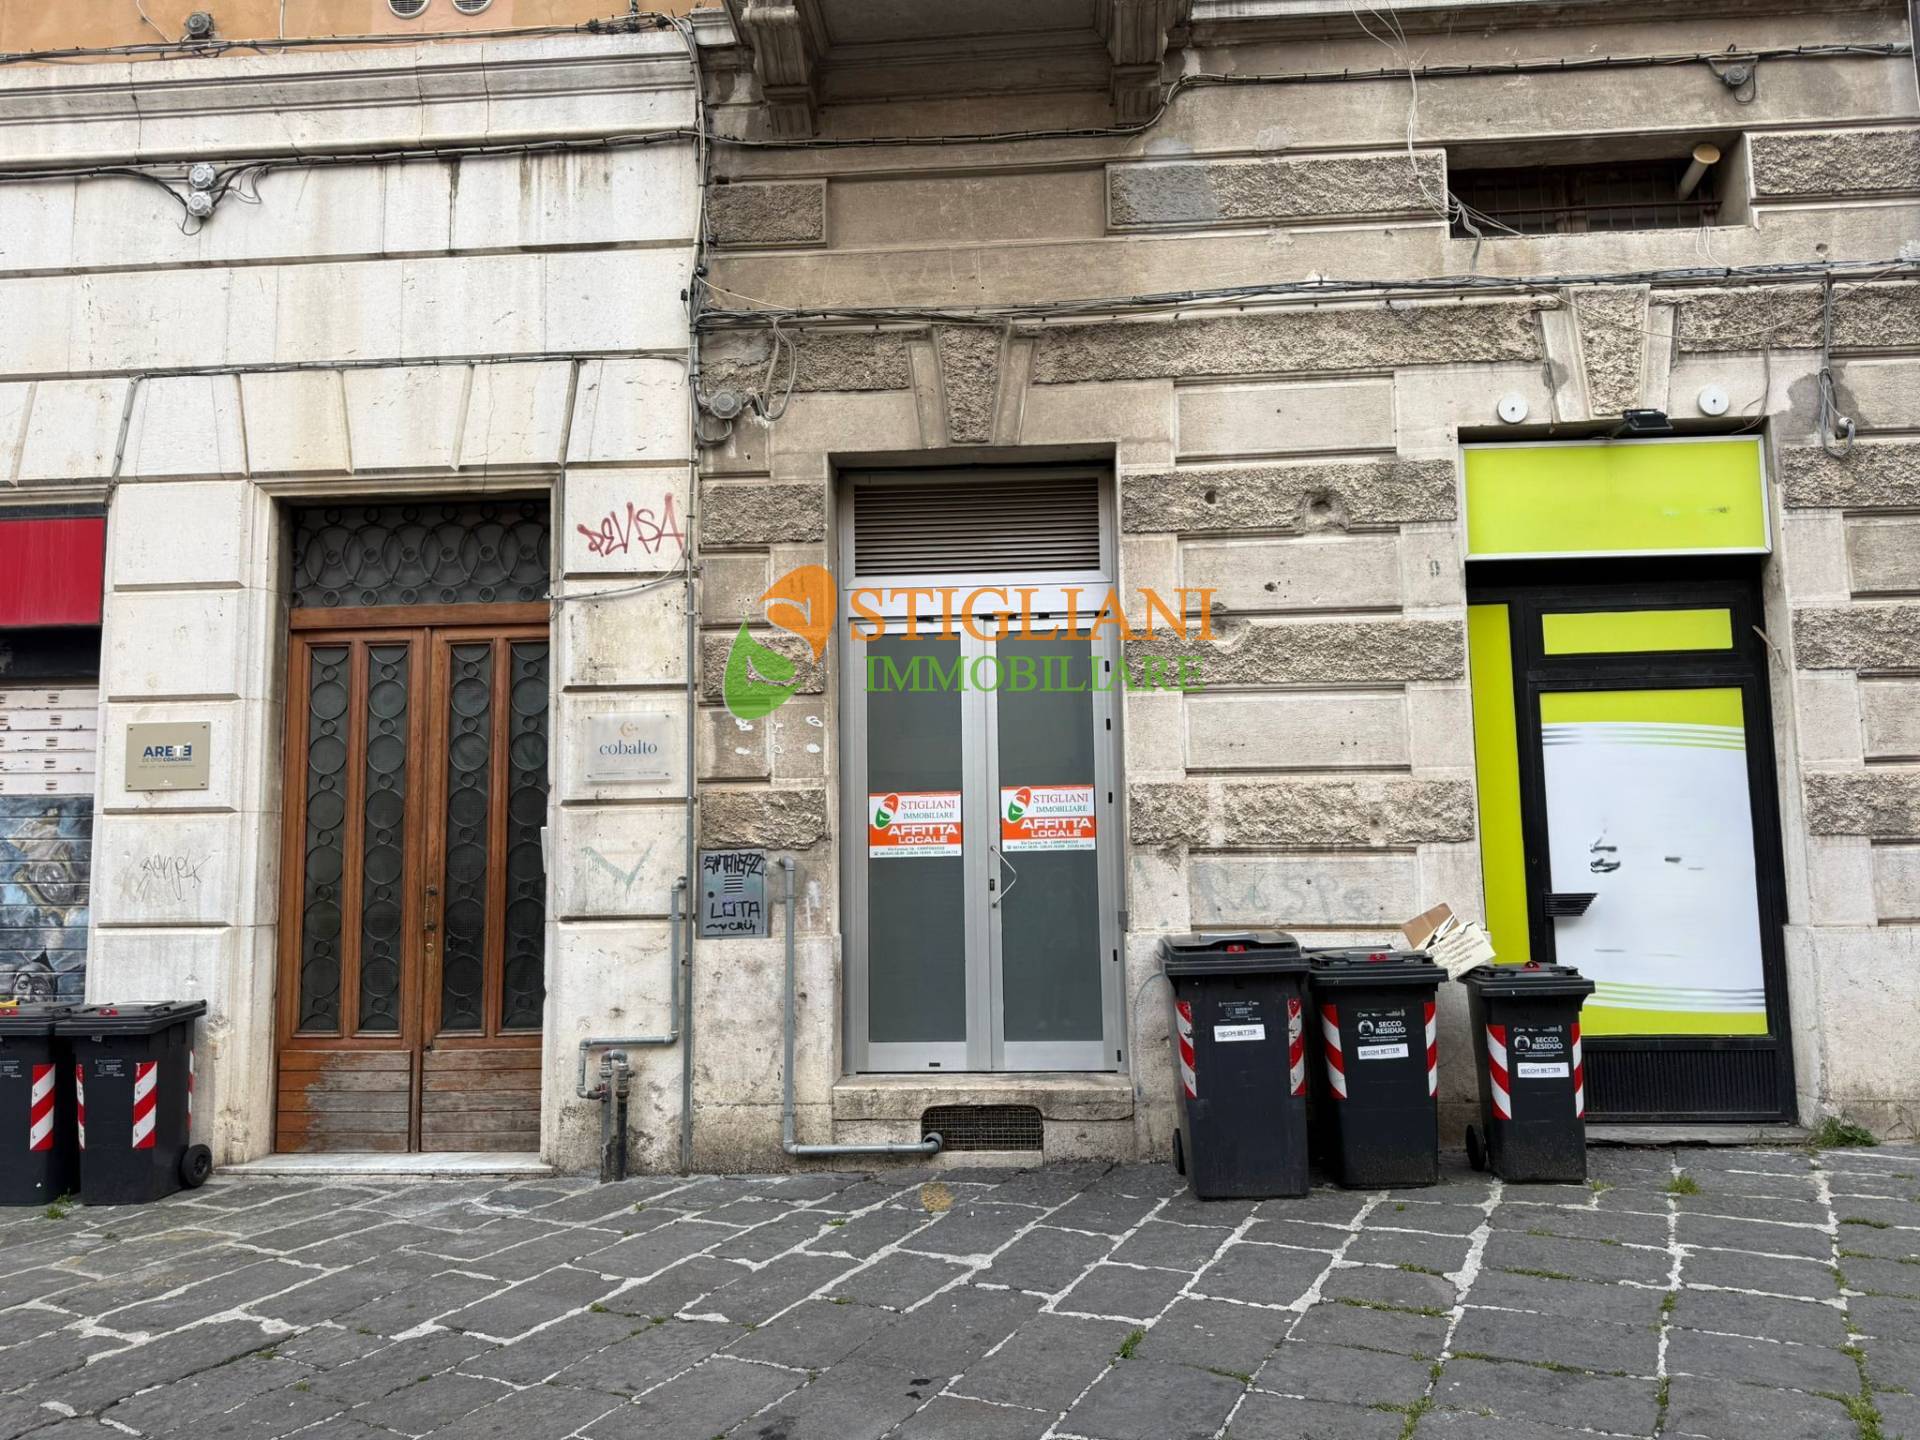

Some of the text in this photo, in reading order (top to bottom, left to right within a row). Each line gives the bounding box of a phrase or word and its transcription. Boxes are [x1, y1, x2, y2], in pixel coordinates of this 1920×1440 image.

[599, 739, 658, 756] cobalto
[1033, 793, 1089, 804] STIGLIANI
[901, 800, 956, 810] STIGLIANI
[1036, 804, 1088, 813] IMMOBILIARE
[903, 811, 955, 820] IMMOBILIARE
[1020, 817, 1092, 830] AFFITTA
[887, 823, 958, 836] AFFITTA
[1031, 829, 1082, 838] LOCALE
[898, 835, 948, 844] LOCALE
[1378, 1020, 1402, 1028] SECCO
[1375, 1027, 1406, 1035] RESIDUO
[1532, 1042, 1563, 1050] RESIDUO
